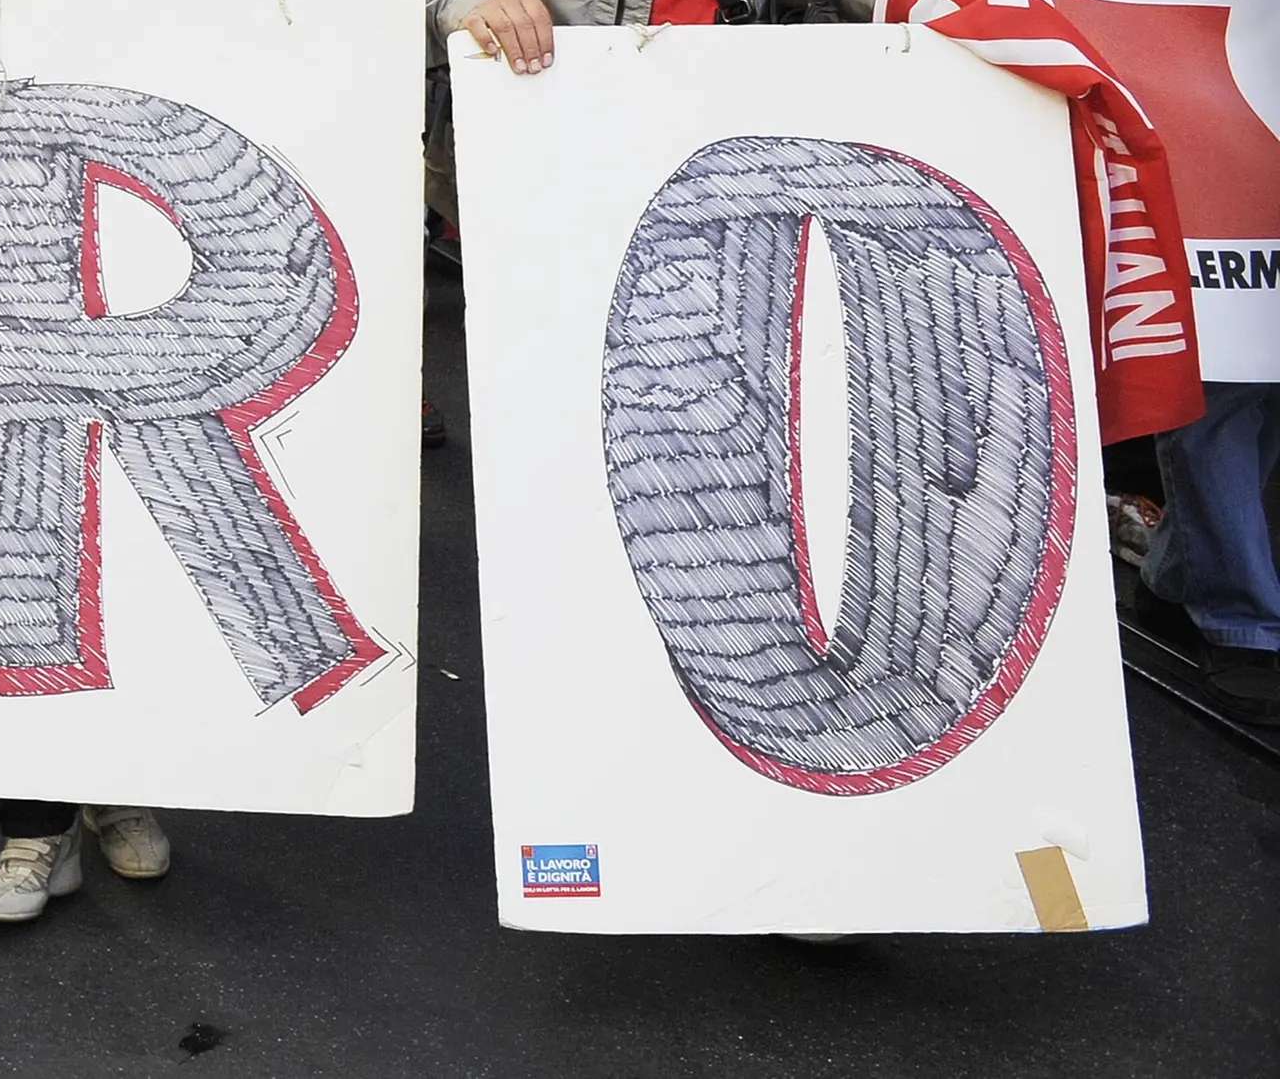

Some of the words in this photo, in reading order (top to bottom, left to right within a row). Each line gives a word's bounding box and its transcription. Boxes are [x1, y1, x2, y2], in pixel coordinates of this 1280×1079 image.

[526, 860, 538, 870] IL
[540, 859, 591, 870] LAVORO
[538, 869, 592, 882] DIGNITÀ
